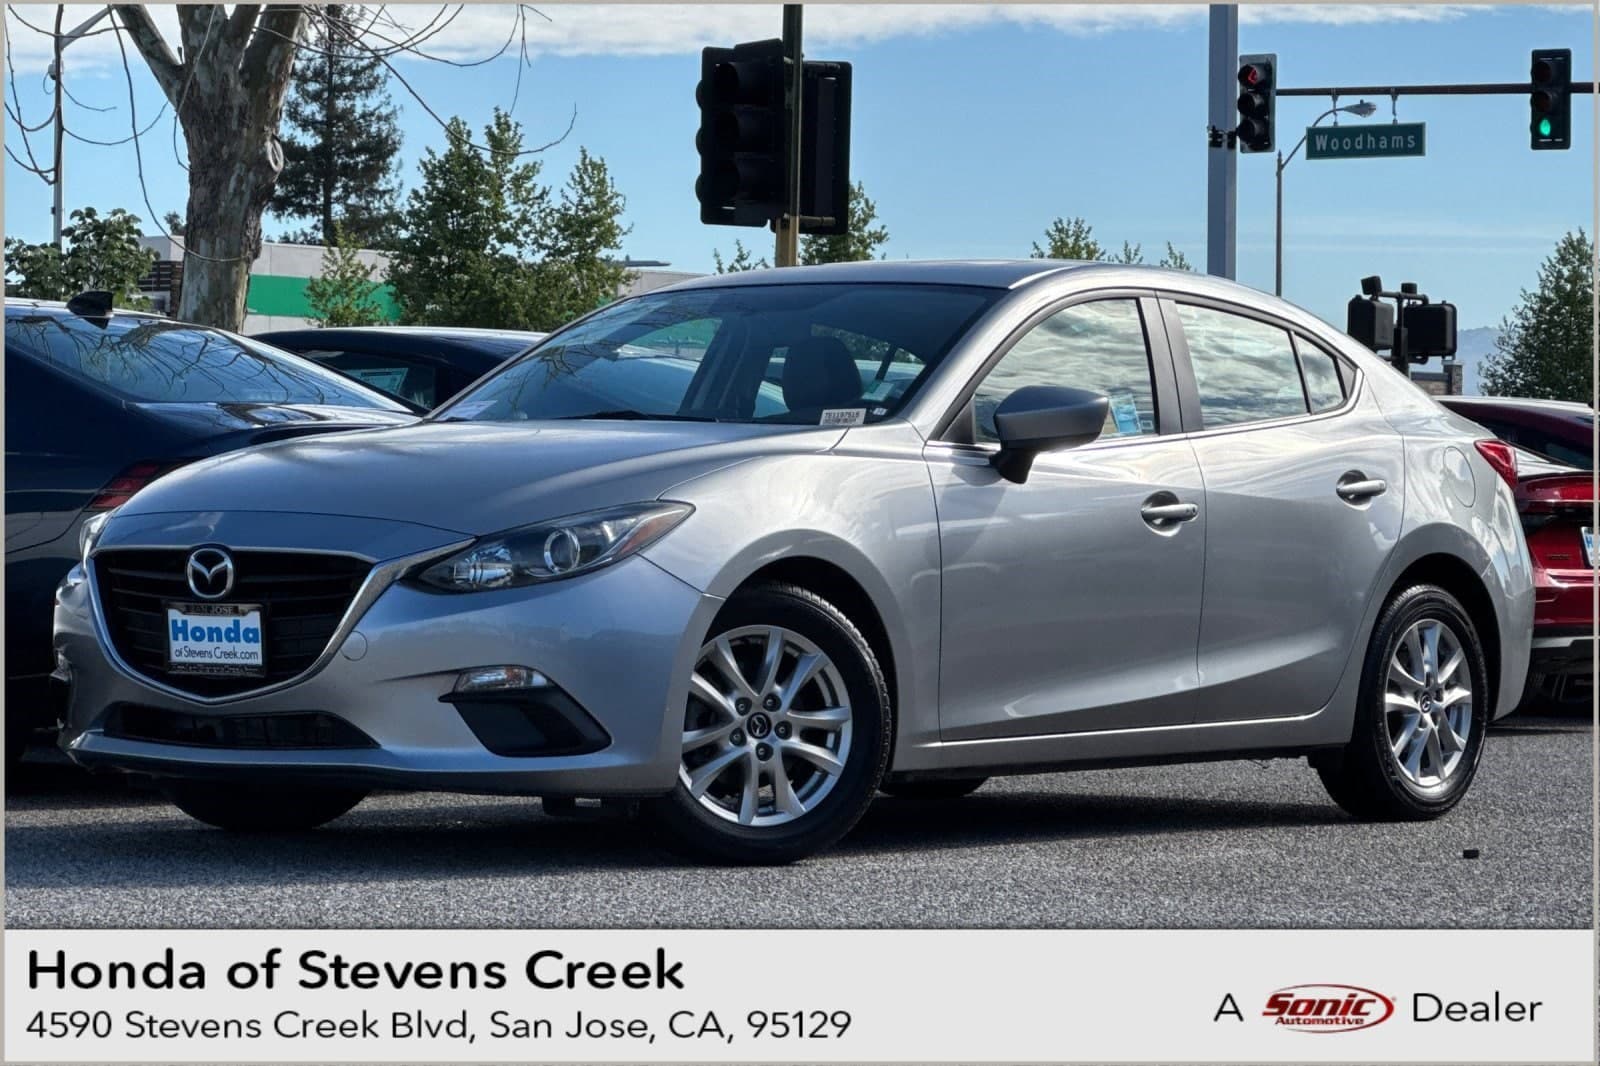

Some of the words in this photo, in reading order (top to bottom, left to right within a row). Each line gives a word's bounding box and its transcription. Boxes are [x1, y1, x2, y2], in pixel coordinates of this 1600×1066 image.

[1315, 133, 1416, 151] Woodhams
[171, 619, 260, 643] Honda
[175, 648, 183, 657] of
[184, 645, 212, 659] Stevens
[213, 646, 259, 660] Creek.com
